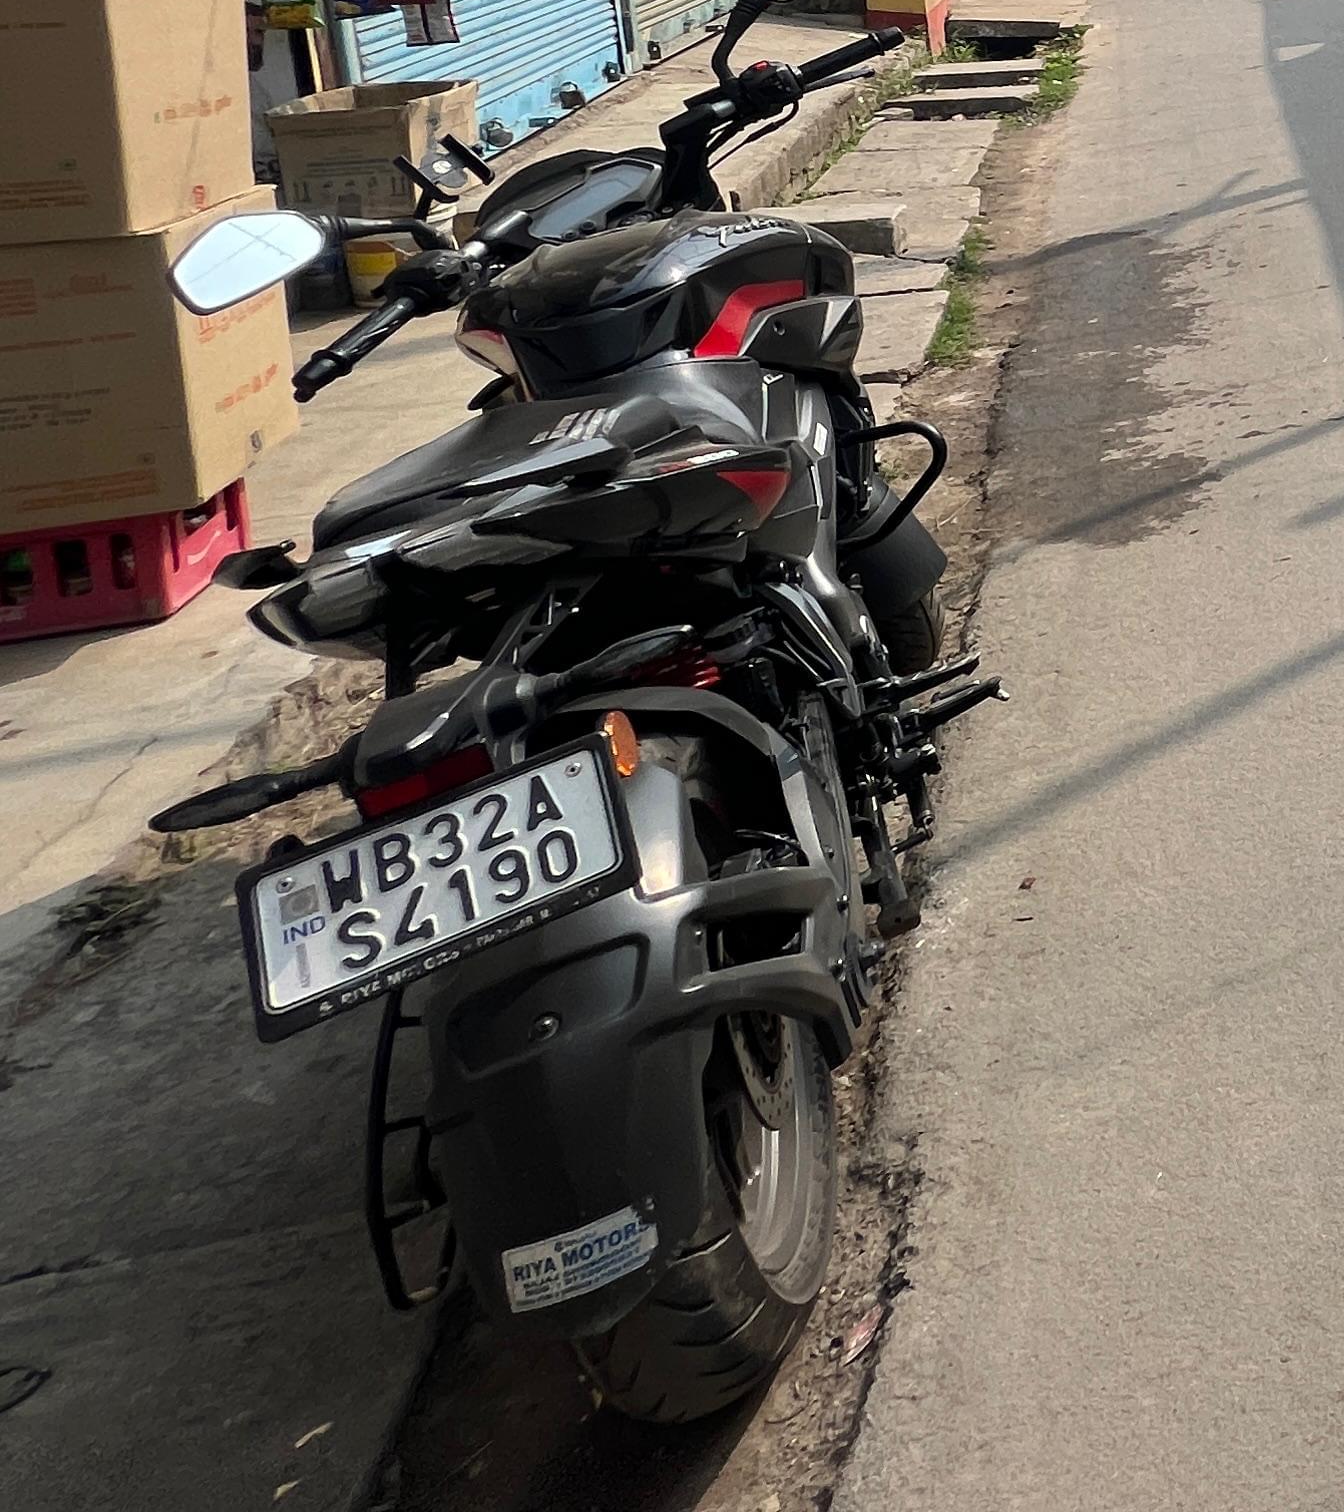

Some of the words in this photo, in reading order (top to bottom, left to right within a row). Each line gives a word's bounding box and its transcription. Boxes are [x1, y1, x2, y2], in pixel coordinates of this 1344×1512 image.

[322, 776, 564, 913] WB32A
[283, 915, 326, 945] IND
[337, 830, 579, 969] S4190
[512, 1256, 557, 1282] RIYA
